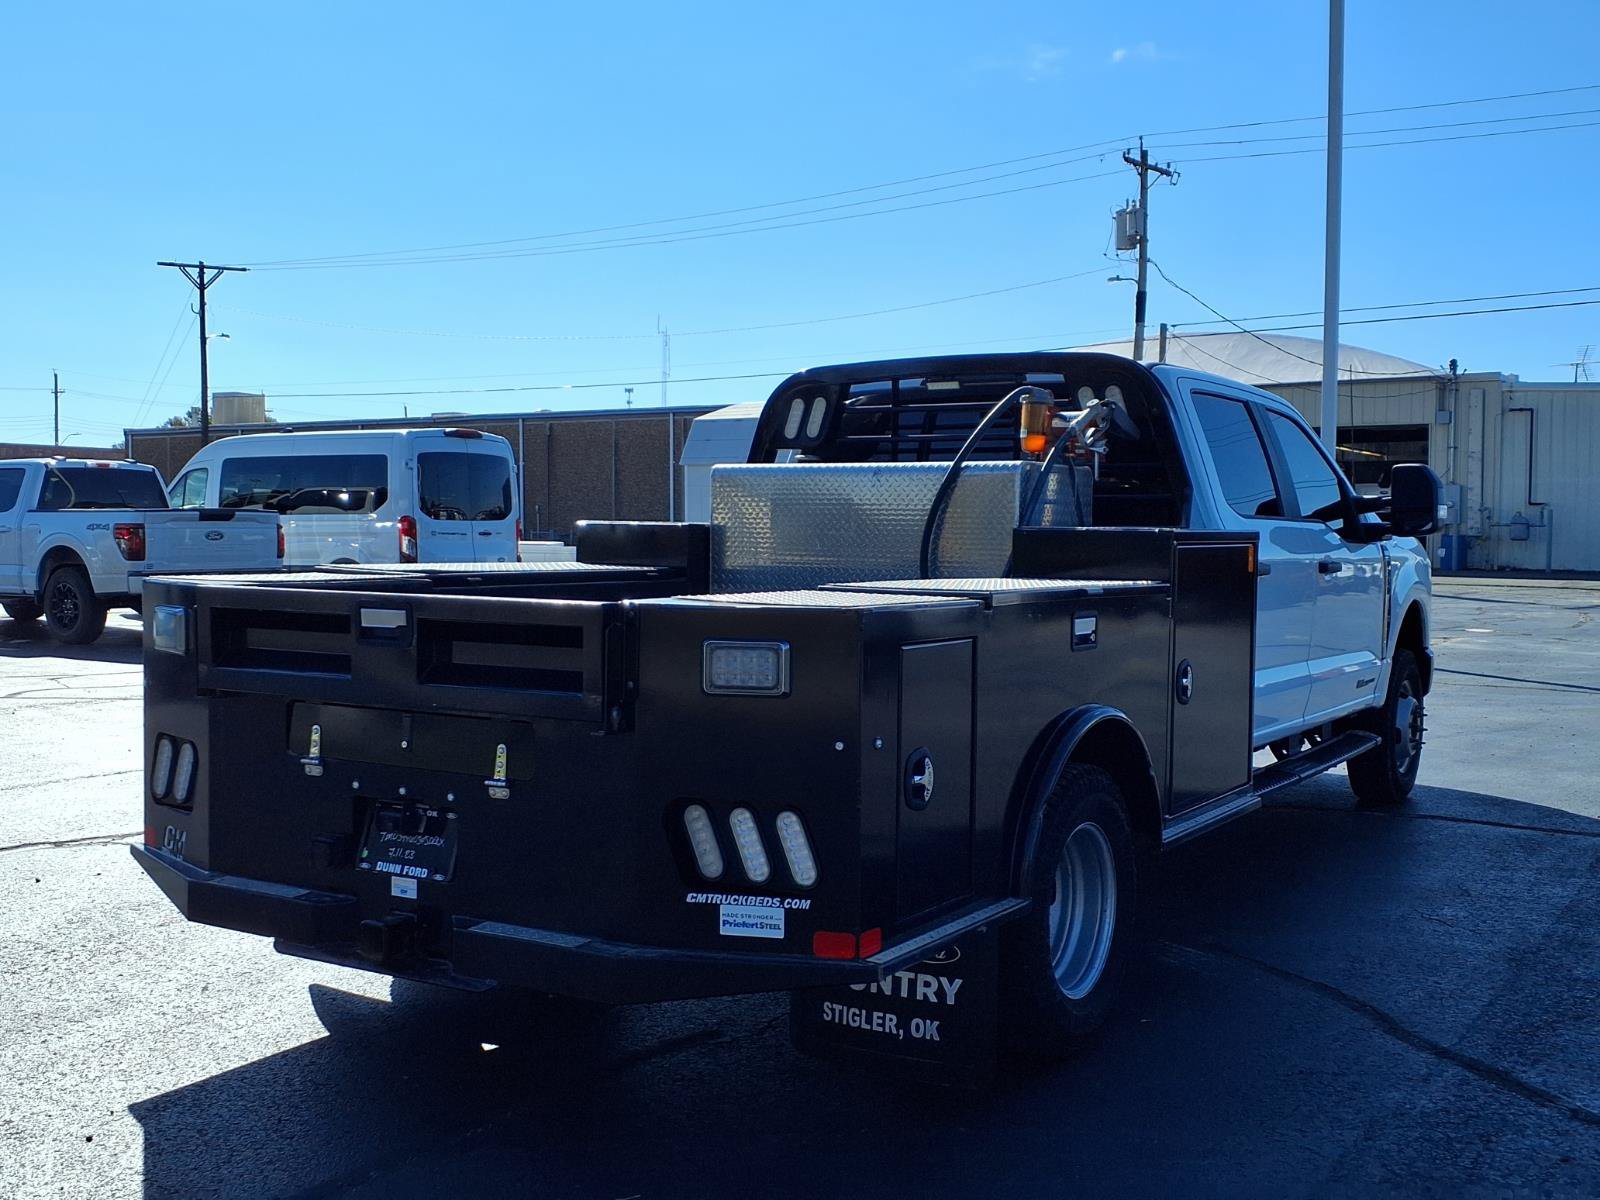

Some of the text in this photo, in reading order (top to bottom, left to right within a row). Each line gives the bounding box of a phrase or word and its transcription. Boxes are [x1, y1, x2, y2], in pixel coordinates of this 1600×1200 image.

[376, 861, 402, 874] DUNN
[403, 865, 428, 878] FORD
[686, 892, 811, 910] CMTRUCKBEDS.COM
[848, 971, 964, 1005] NTRY
[822, 1001, 941, 1041] STIGLER, OK
